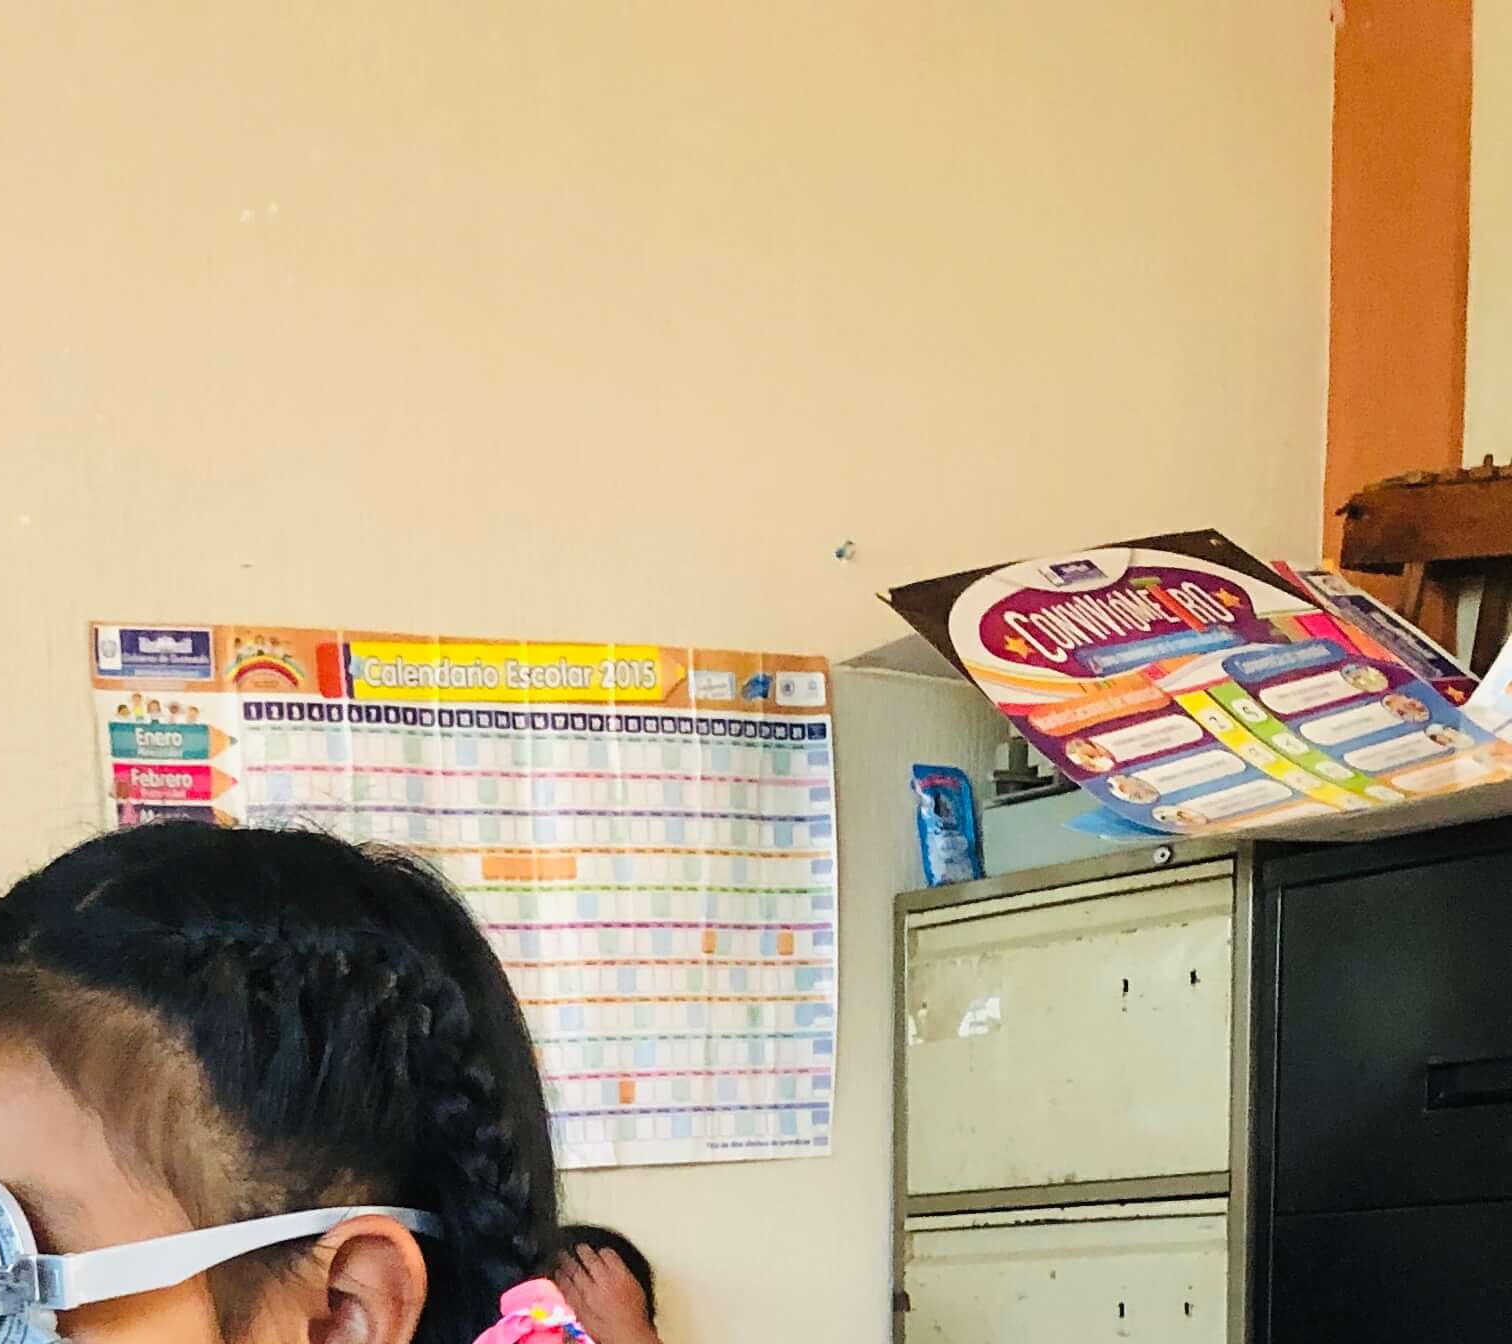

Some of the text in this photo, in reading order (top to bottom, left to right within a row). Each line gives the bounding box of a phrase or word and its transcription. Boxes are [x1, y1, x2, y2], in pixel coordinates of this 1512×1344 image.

[364, 656, 656, 689] Calendario Escolar 2015
[136, 728, 183, 747] Enero
[131, 768, 193, 788] Febrero
